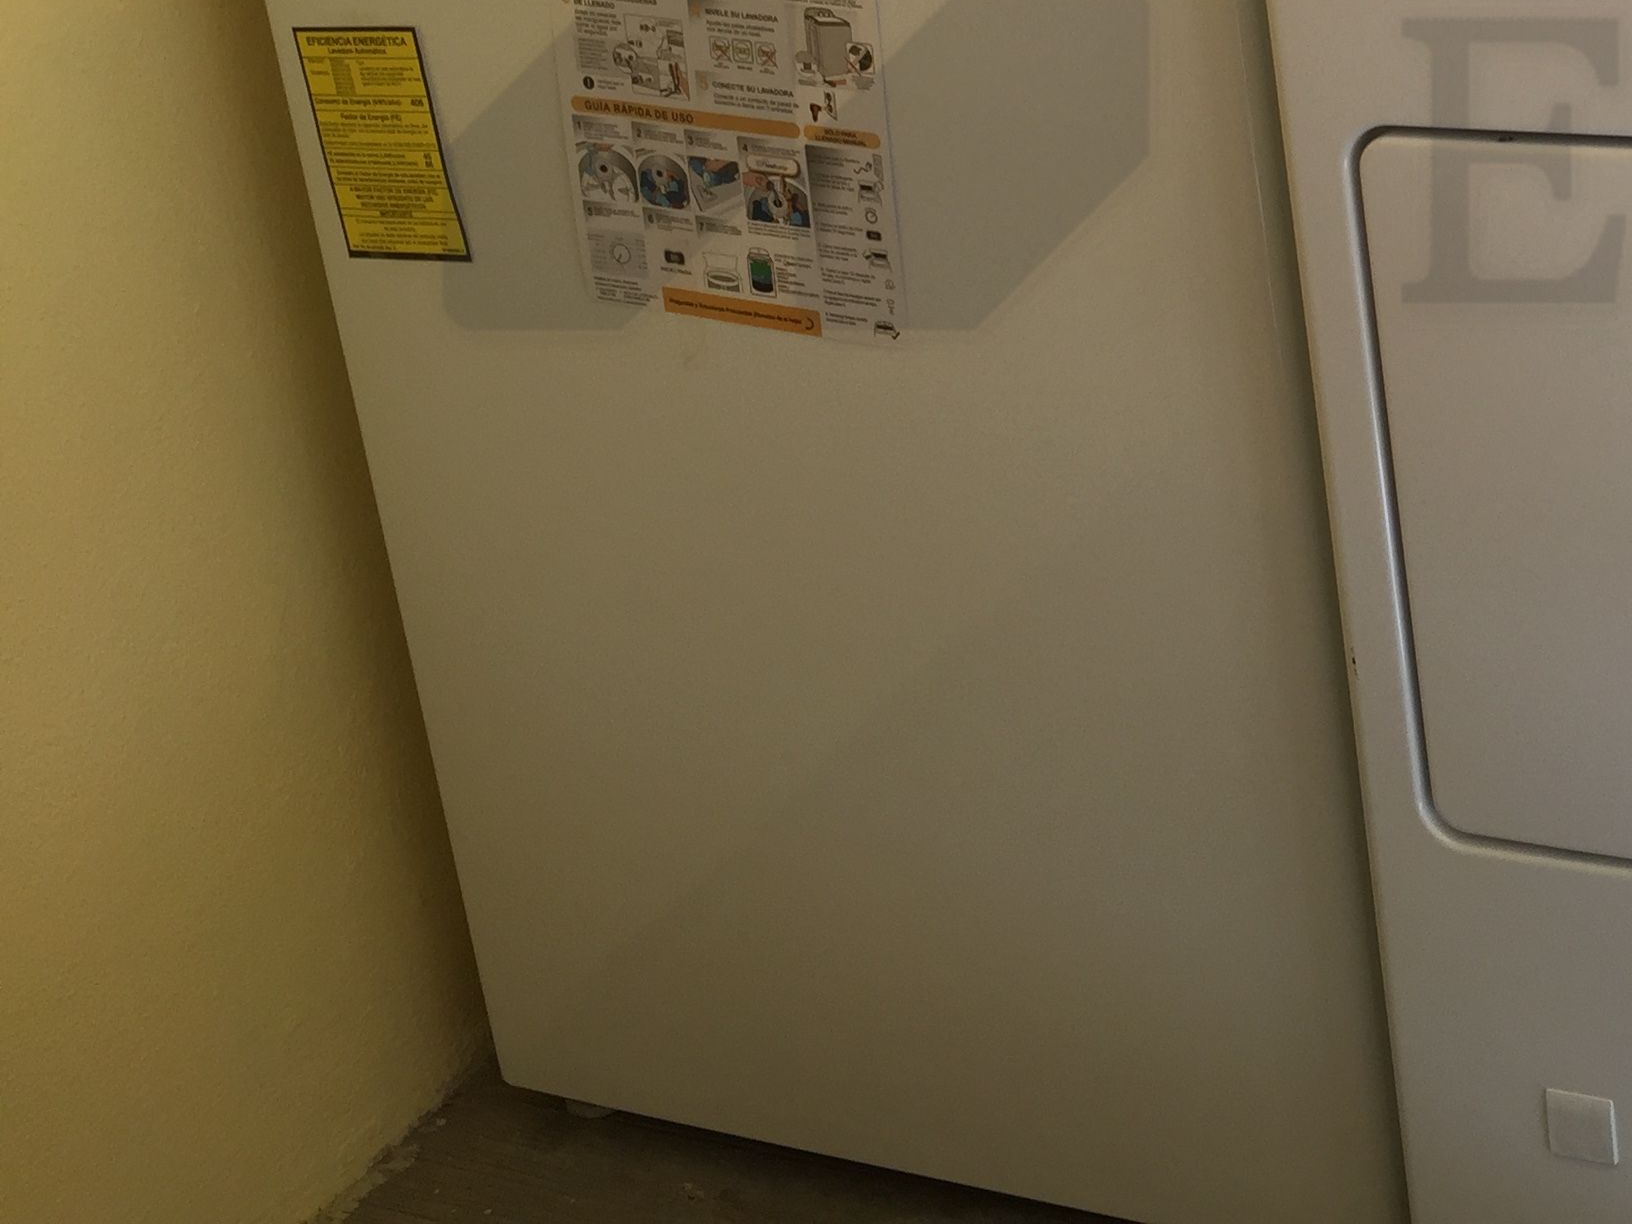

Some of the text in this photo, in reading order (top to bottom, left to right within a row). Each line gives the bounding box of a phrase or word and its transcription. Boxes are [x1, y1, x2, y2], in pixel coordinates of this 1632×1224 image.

[741, 11, 779, 23] LAVADORA
[306, 34, 408, 47] EFICIENCIA ENERGÉTICA
[712, 81, 745, 91] CONECTE
[757, 85, 794, 98] LAVADORA
[584, 99, 695, 123] GUÍA RÁPIDA DE USO
